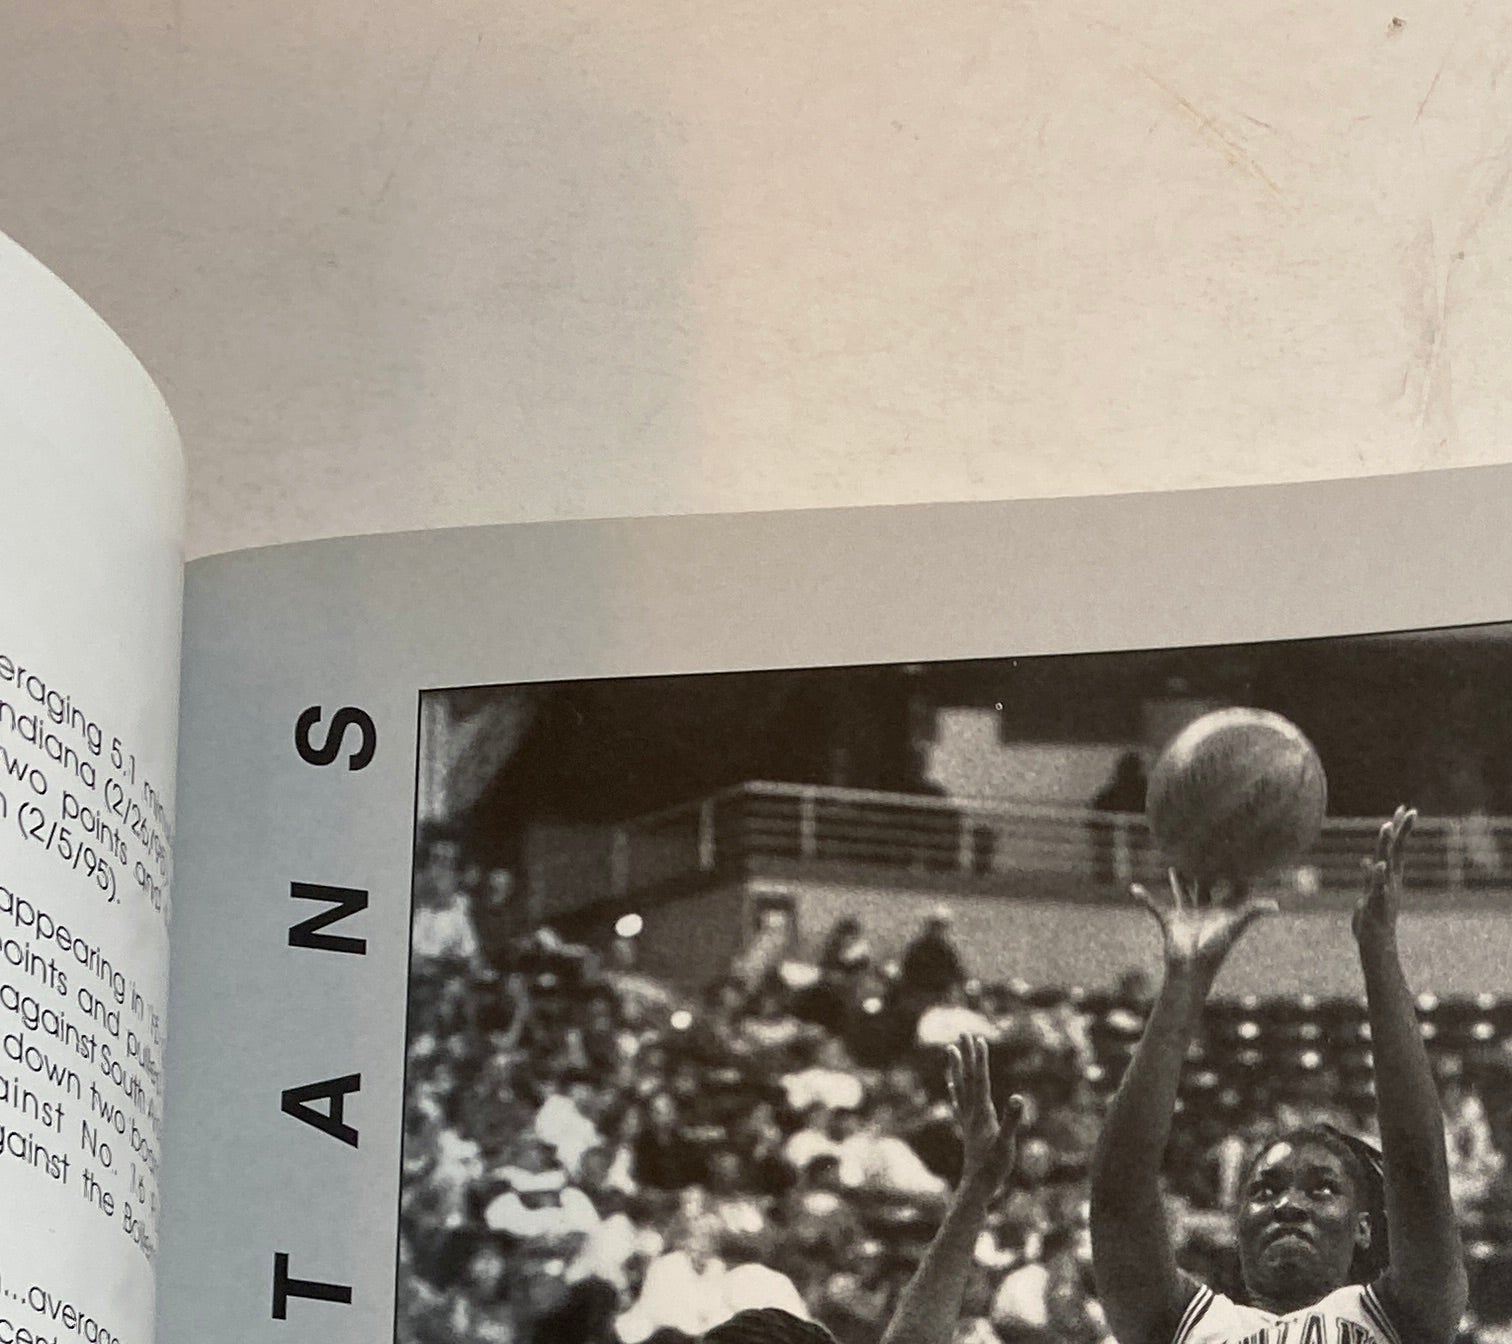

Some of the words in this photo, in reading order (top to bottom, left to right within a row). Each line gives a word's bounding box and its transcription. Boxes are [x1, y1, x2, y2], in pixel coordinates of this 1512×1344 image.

[111, 737, 136, 785] 5.1
[18, 801, 121, 905] (2/5/95).
[63, 790, 128, 866] points
[0, 887, 127, 1005] appearing
[0, 984, 96, 1063] against
[78, 987, 120, 1038] and
[3, 1032, 81, 1101] down
[90, 1080, 126, 1135] two
[83, 1167, 115, 1217] the
